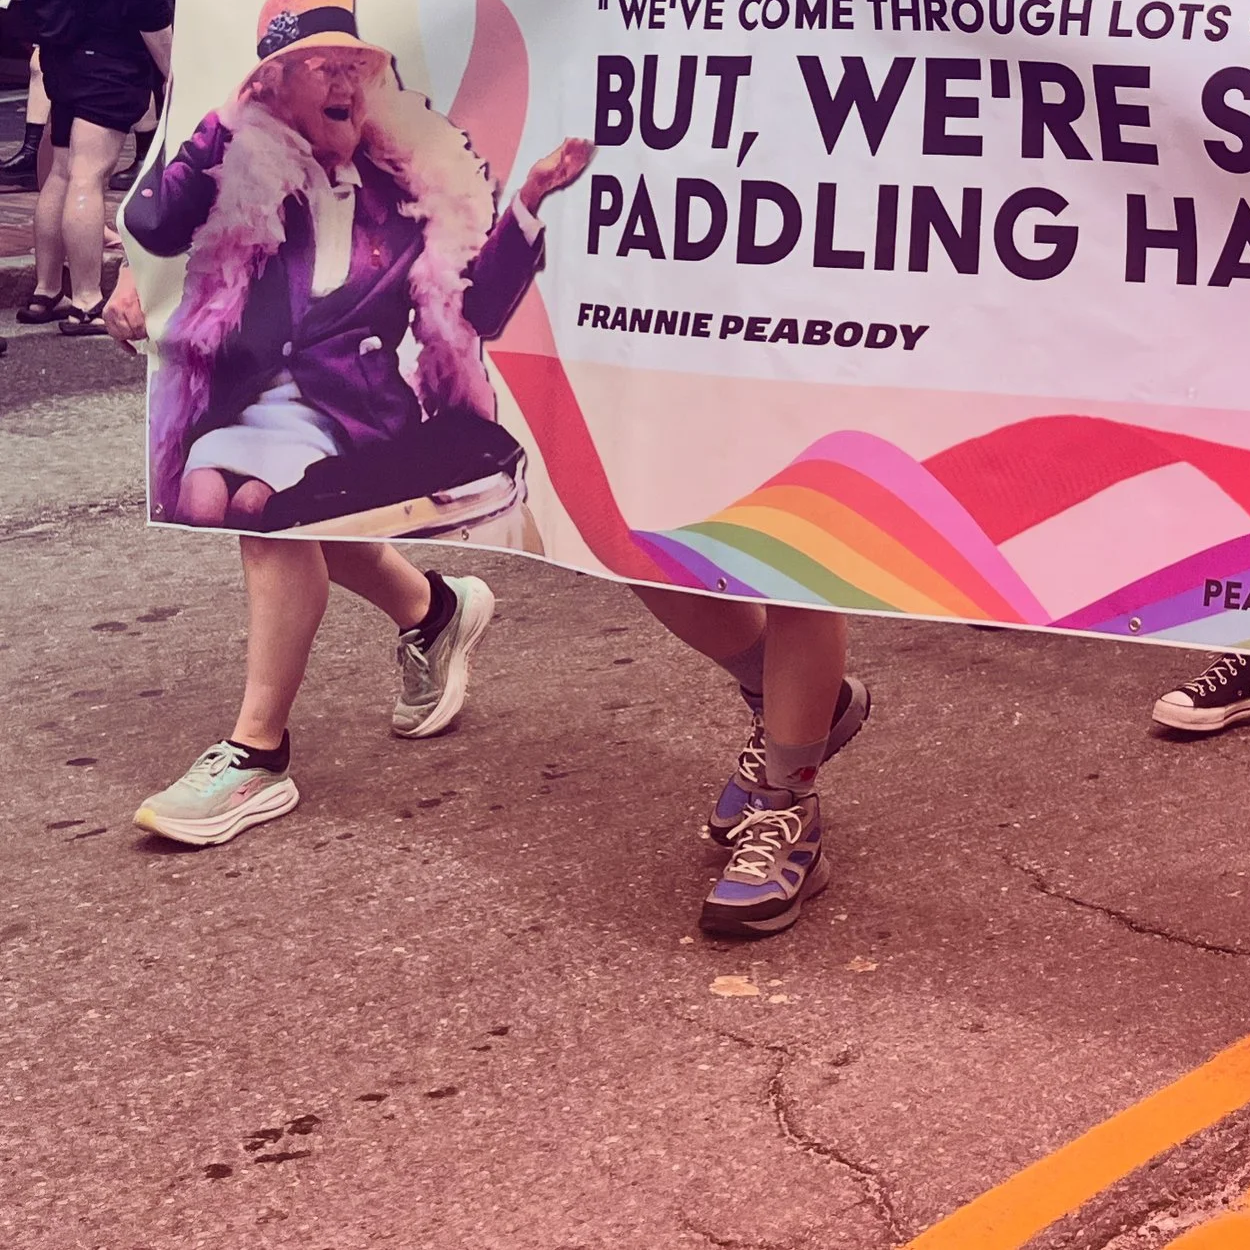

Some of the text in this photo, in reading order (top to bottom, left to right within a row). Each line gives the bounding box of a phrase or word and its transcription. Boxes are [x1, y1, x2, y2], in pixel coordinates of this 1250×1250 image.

[1108, 0, 1232, 42] LOTS
[594, 54, 759, 168] BUT,
[796, 55, 1160, 167] WE'RE
[587, 173, 1079, 281] PADDLING
[577, 302, 930, 351] FRANNIE PEABODY
